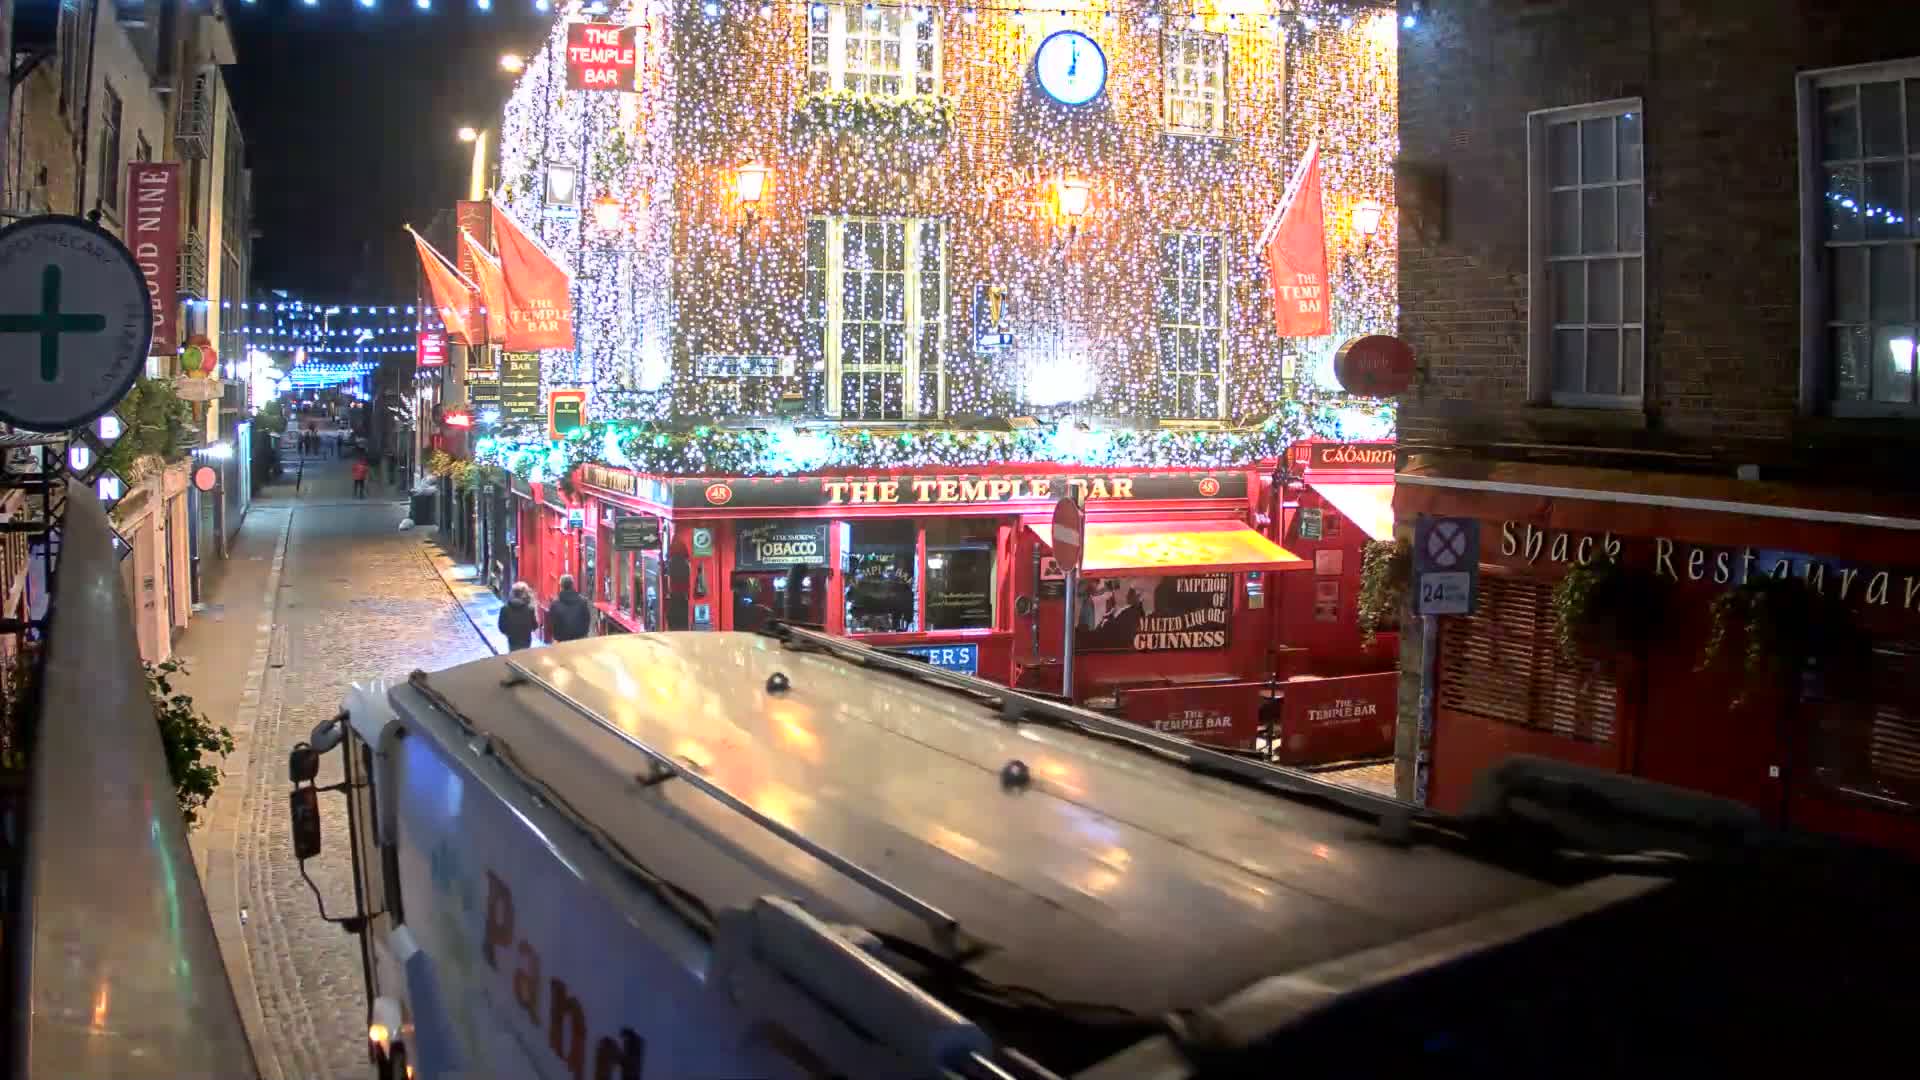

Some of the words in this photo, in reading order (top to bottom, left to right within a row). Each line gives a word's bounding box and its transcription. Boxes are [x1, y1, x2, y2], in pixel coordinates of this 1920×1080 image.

[585, 29, 619, 45] THE
[569, 48, 634, 64] TEMPLE
[585, 69, 618, 84] BAR
[136, 170, 169, 232] NINE
[1296, 273, 1320, 284] THE
[529, 300, 553, 308] THE
[511, 309, 570, 323] TEMPLE
[528, 322, 559, 332] BAR
[824, 481, 899, 504] THE
[912, 480, 1051, 503] TEMPLE
[752, 539, 817, 561] TOBACCO
[1177, 578, 1228, 593] EMPEROR
[1423, 583, 1444, 603] 24
[1213, 593, 1225, 608] OF
[1140, 616, 1183, 632] MALTED
[1134, 630, 1225, 650] GUINNESS
[1308, 707, 1353, 721] TEMPLE
[1354, 704, 1377, 716] BAR
[1152, 719, 1203, 731] TEMPLE
[1206, 715, 1232, 728] BAR
